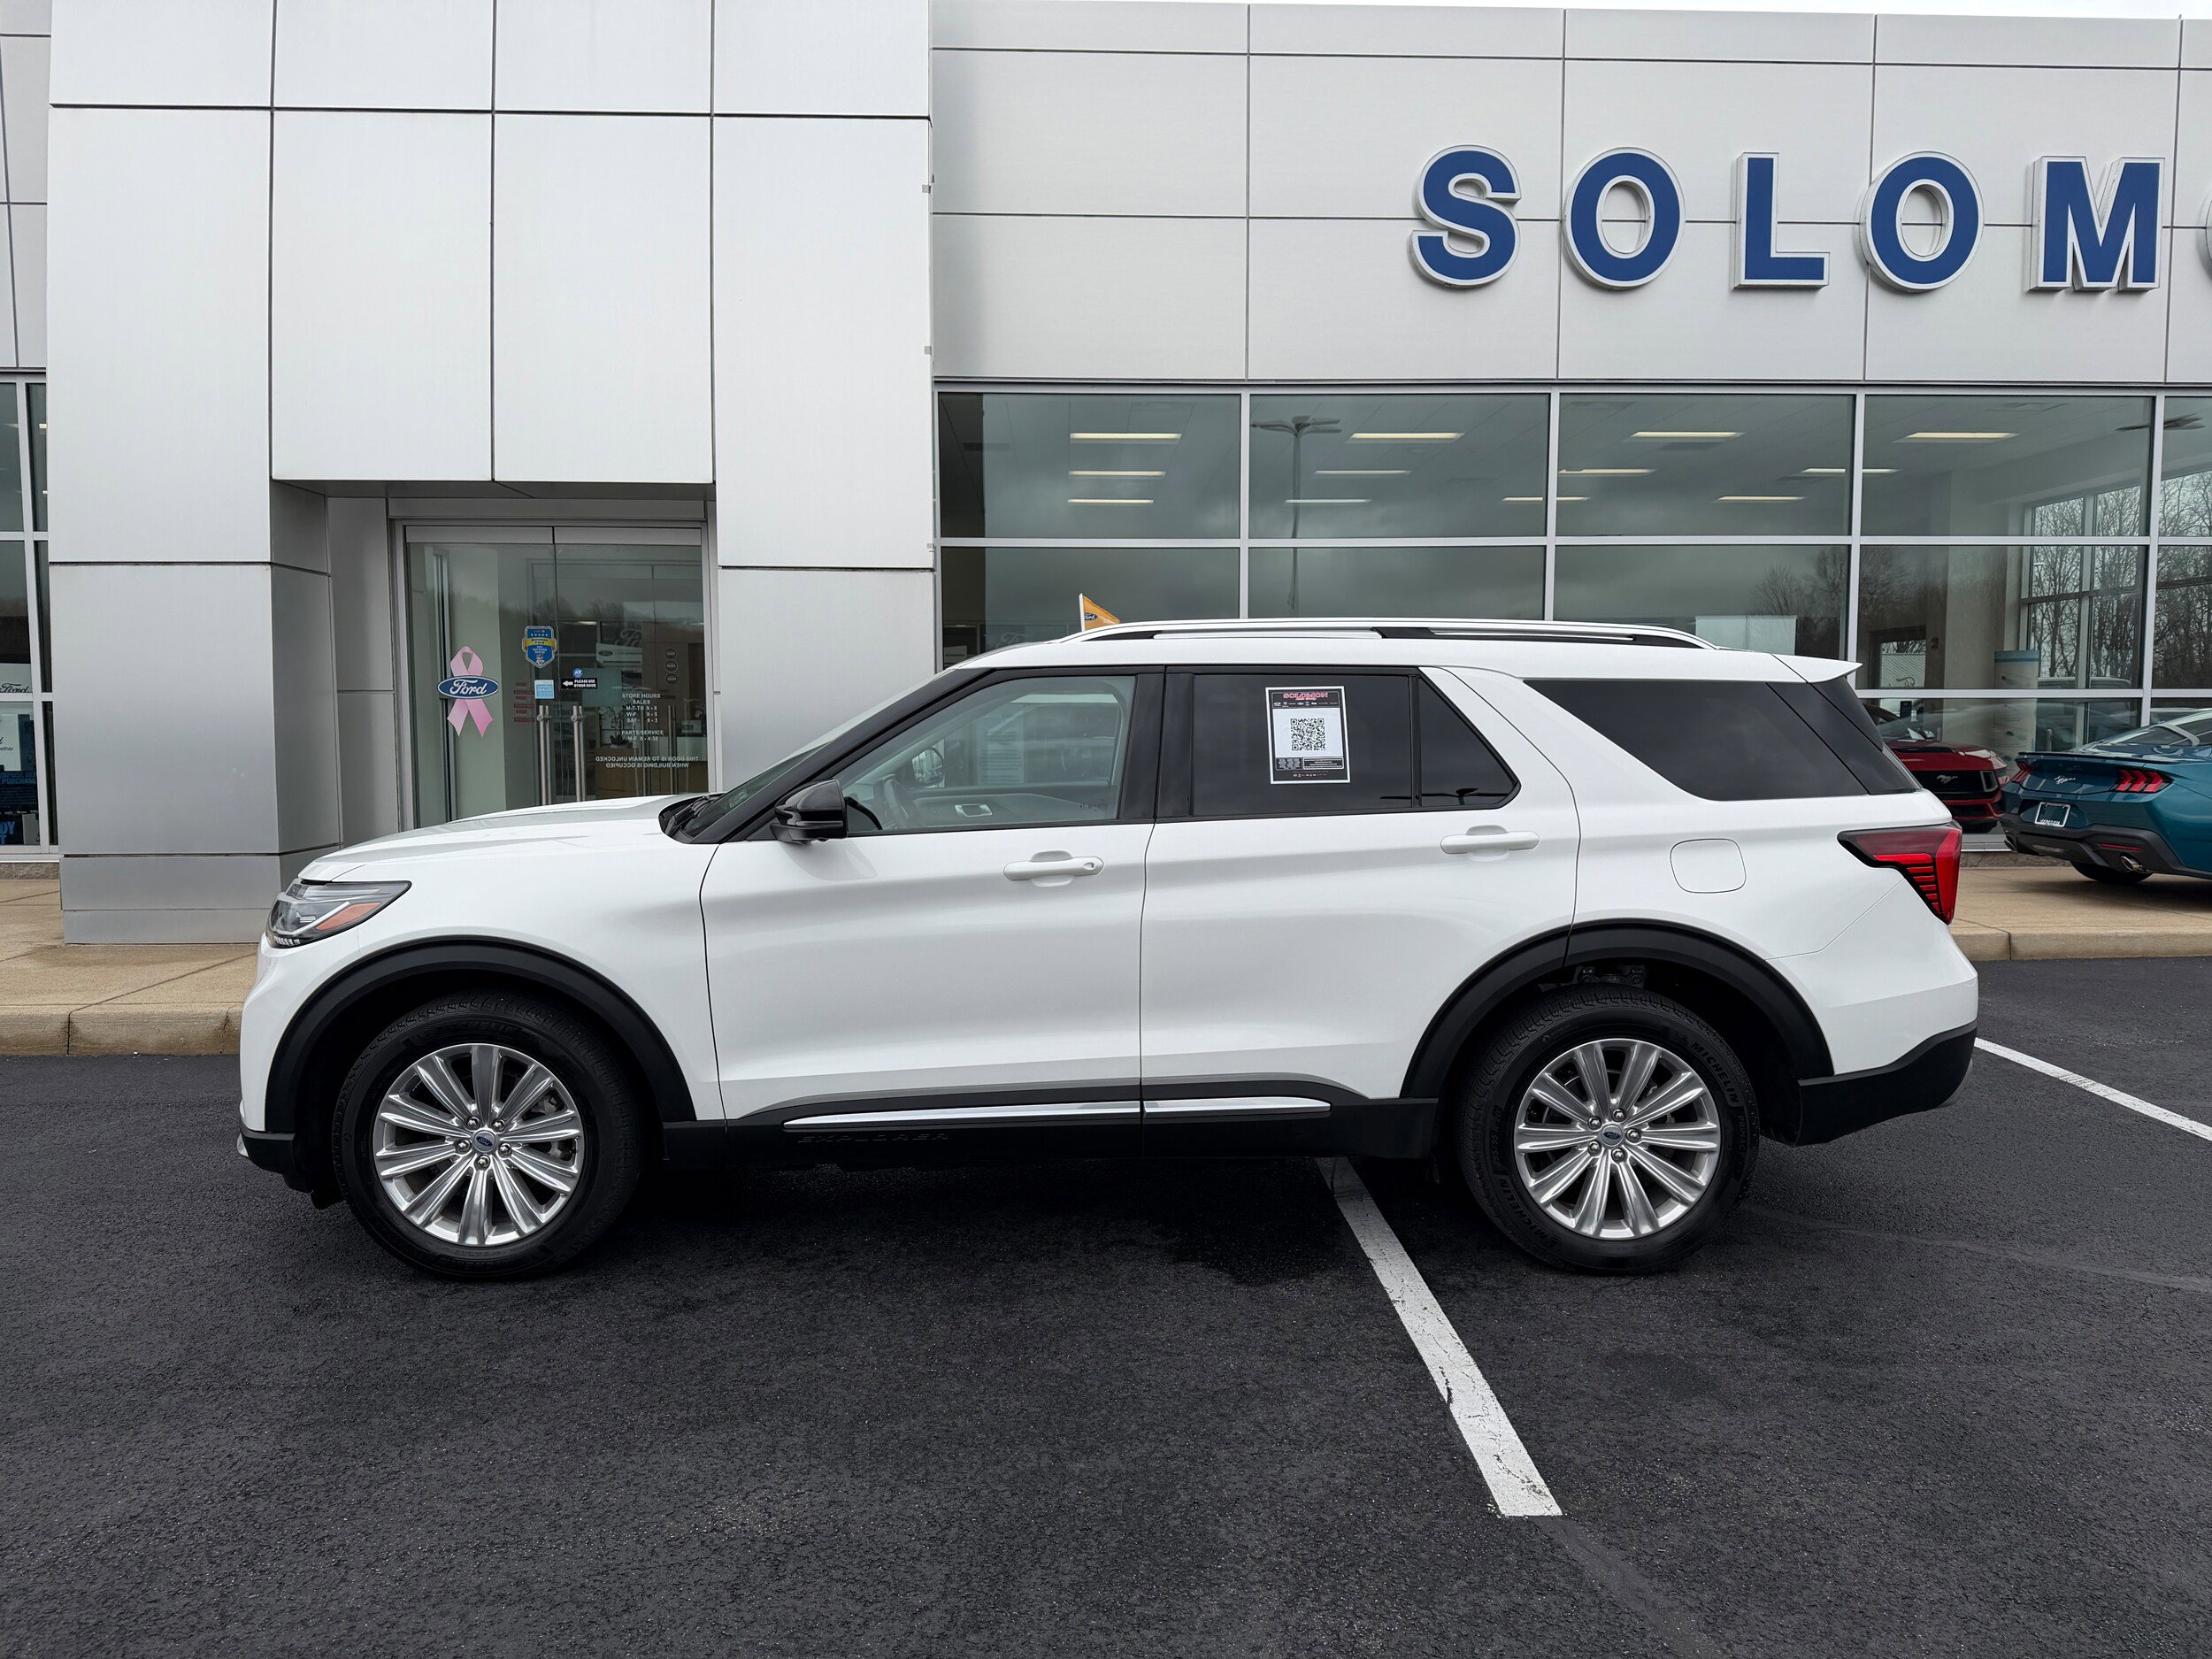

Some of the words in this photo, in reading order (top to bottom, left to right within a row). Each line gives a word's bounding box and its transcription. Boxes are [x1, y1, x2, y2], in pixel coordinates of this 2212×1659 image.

[1411, 145, 2212, 293] SOLOM
[0, 683, 32, 693] Ford
[449, 679, 488, 695] Ford
[1692, 1042, 1740, 1103] MICHELIN
[1499, 1179, 1550, 1240] MICHELIN
